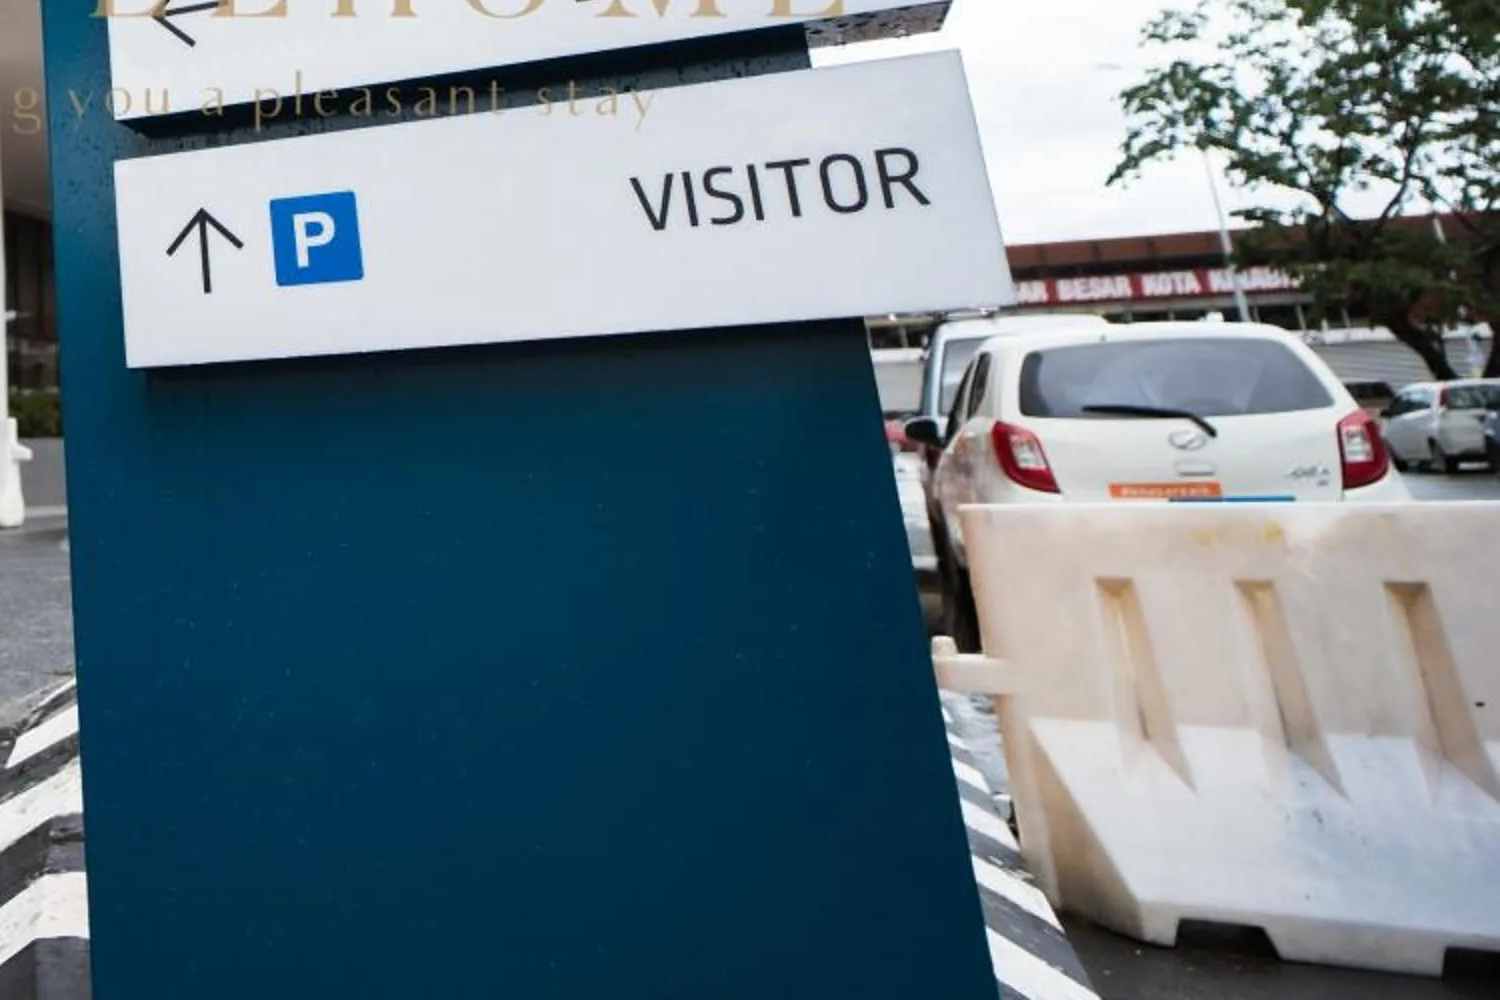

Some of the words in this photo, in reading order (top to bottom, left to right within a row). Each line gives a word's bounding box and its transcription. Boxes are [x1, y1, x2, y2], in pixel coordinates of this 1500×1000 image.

[294, 211, 335, 268] P
[630, 147, 931, 231] VISITOR
[1057, 276, 1132, 300] BESAR
[1142, 271, 1202, 297] KOTA
